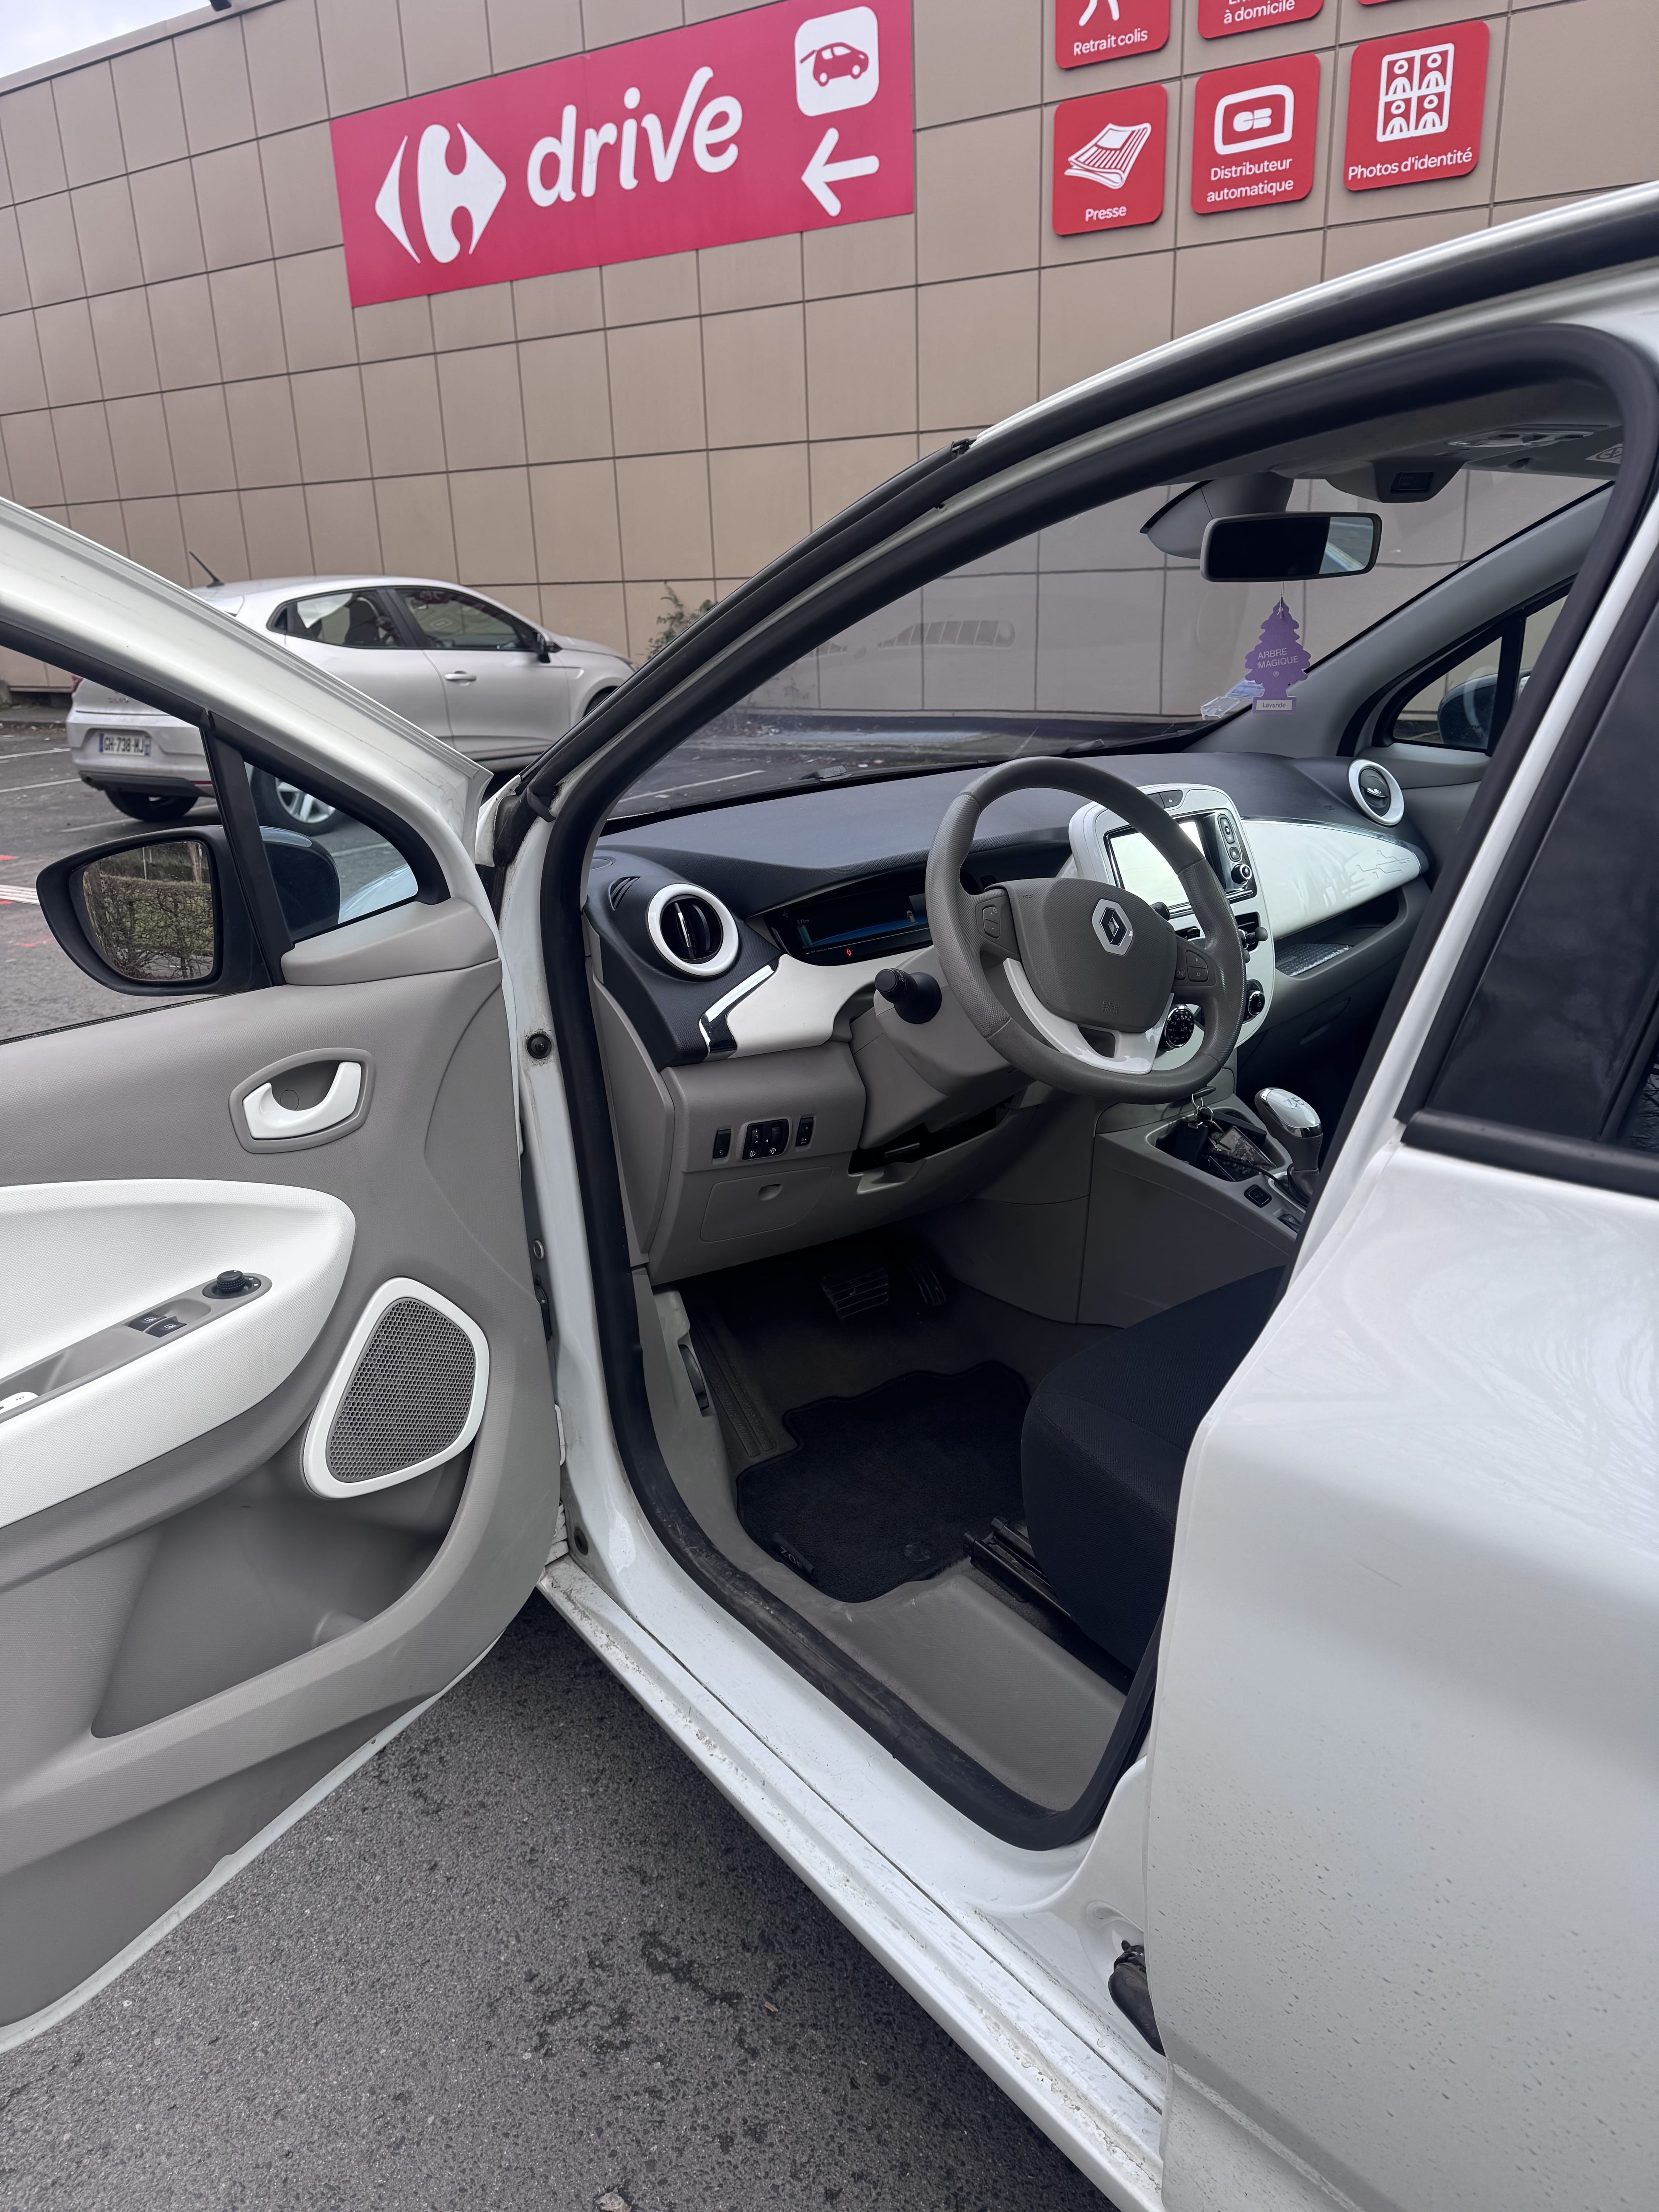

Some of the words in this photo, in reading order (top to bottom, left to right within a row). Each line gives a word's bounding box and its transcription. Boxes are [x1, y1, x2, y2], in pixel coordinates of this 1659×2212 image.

[1223, 9, 1232, 24] à
[1234, 0, 1295, 22] domicile
[1073, 34, 1116, 56] Retrait
[1117, 27, 1148, 46] colis
[527, 66, 742, 207] drive
[1210, 158, 1293, 181] Distributeur
[1348, 162, 1399, 180] Photos
[1400, 146, 1472, 172] d'identité
[1206, 179, 1294, 203] automatique
[1085, 206, 1127, 222] Presse
[1258, 647, 1287, 659] ARBRE
[1258, 655, 1298, 669] MAGIQUE
